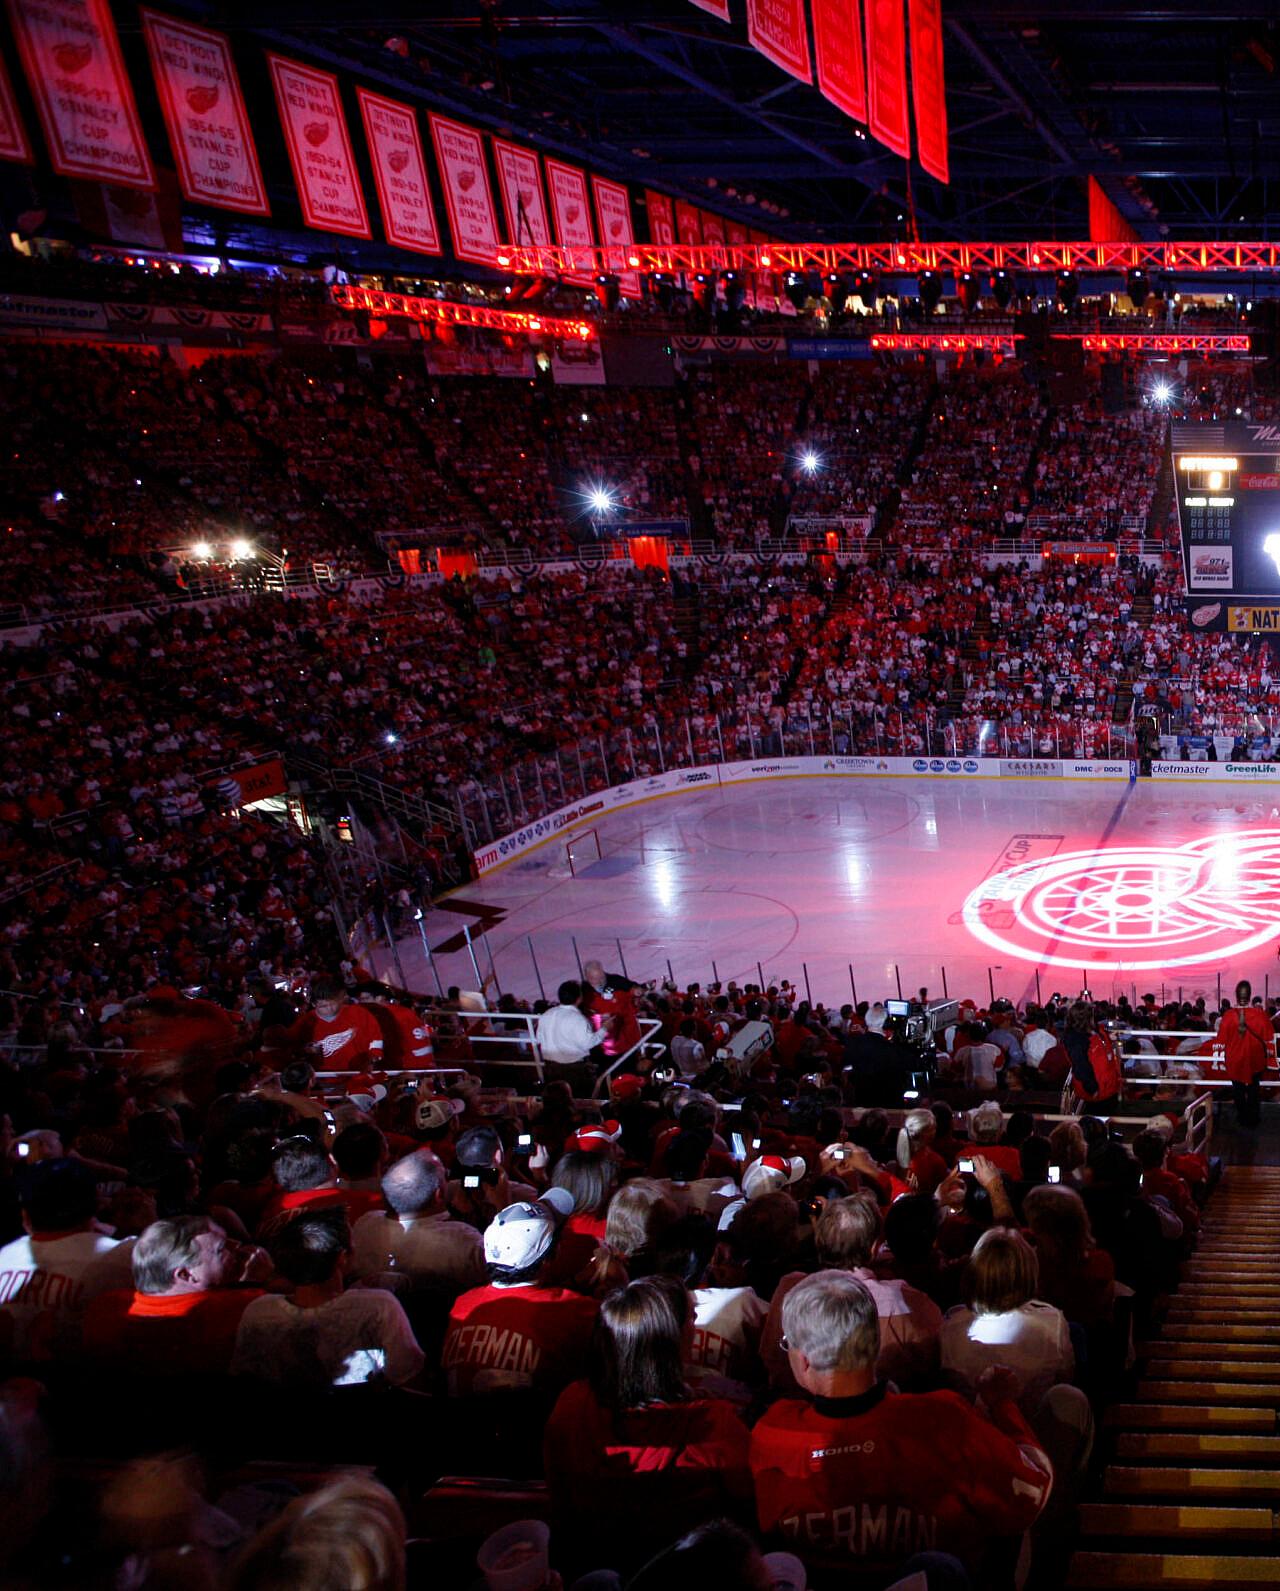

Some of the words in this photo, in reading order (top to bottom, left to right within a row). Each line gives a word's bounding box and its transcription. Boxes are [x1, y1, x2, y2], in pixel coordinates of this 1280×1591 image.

[1007, 762, 1056, 770] CAESARS
[1225, 764, 1277, 774] GreenLife
[1004, 839, 1032, 861] CUP
[811, 1444, 861, 1459] KOHO
